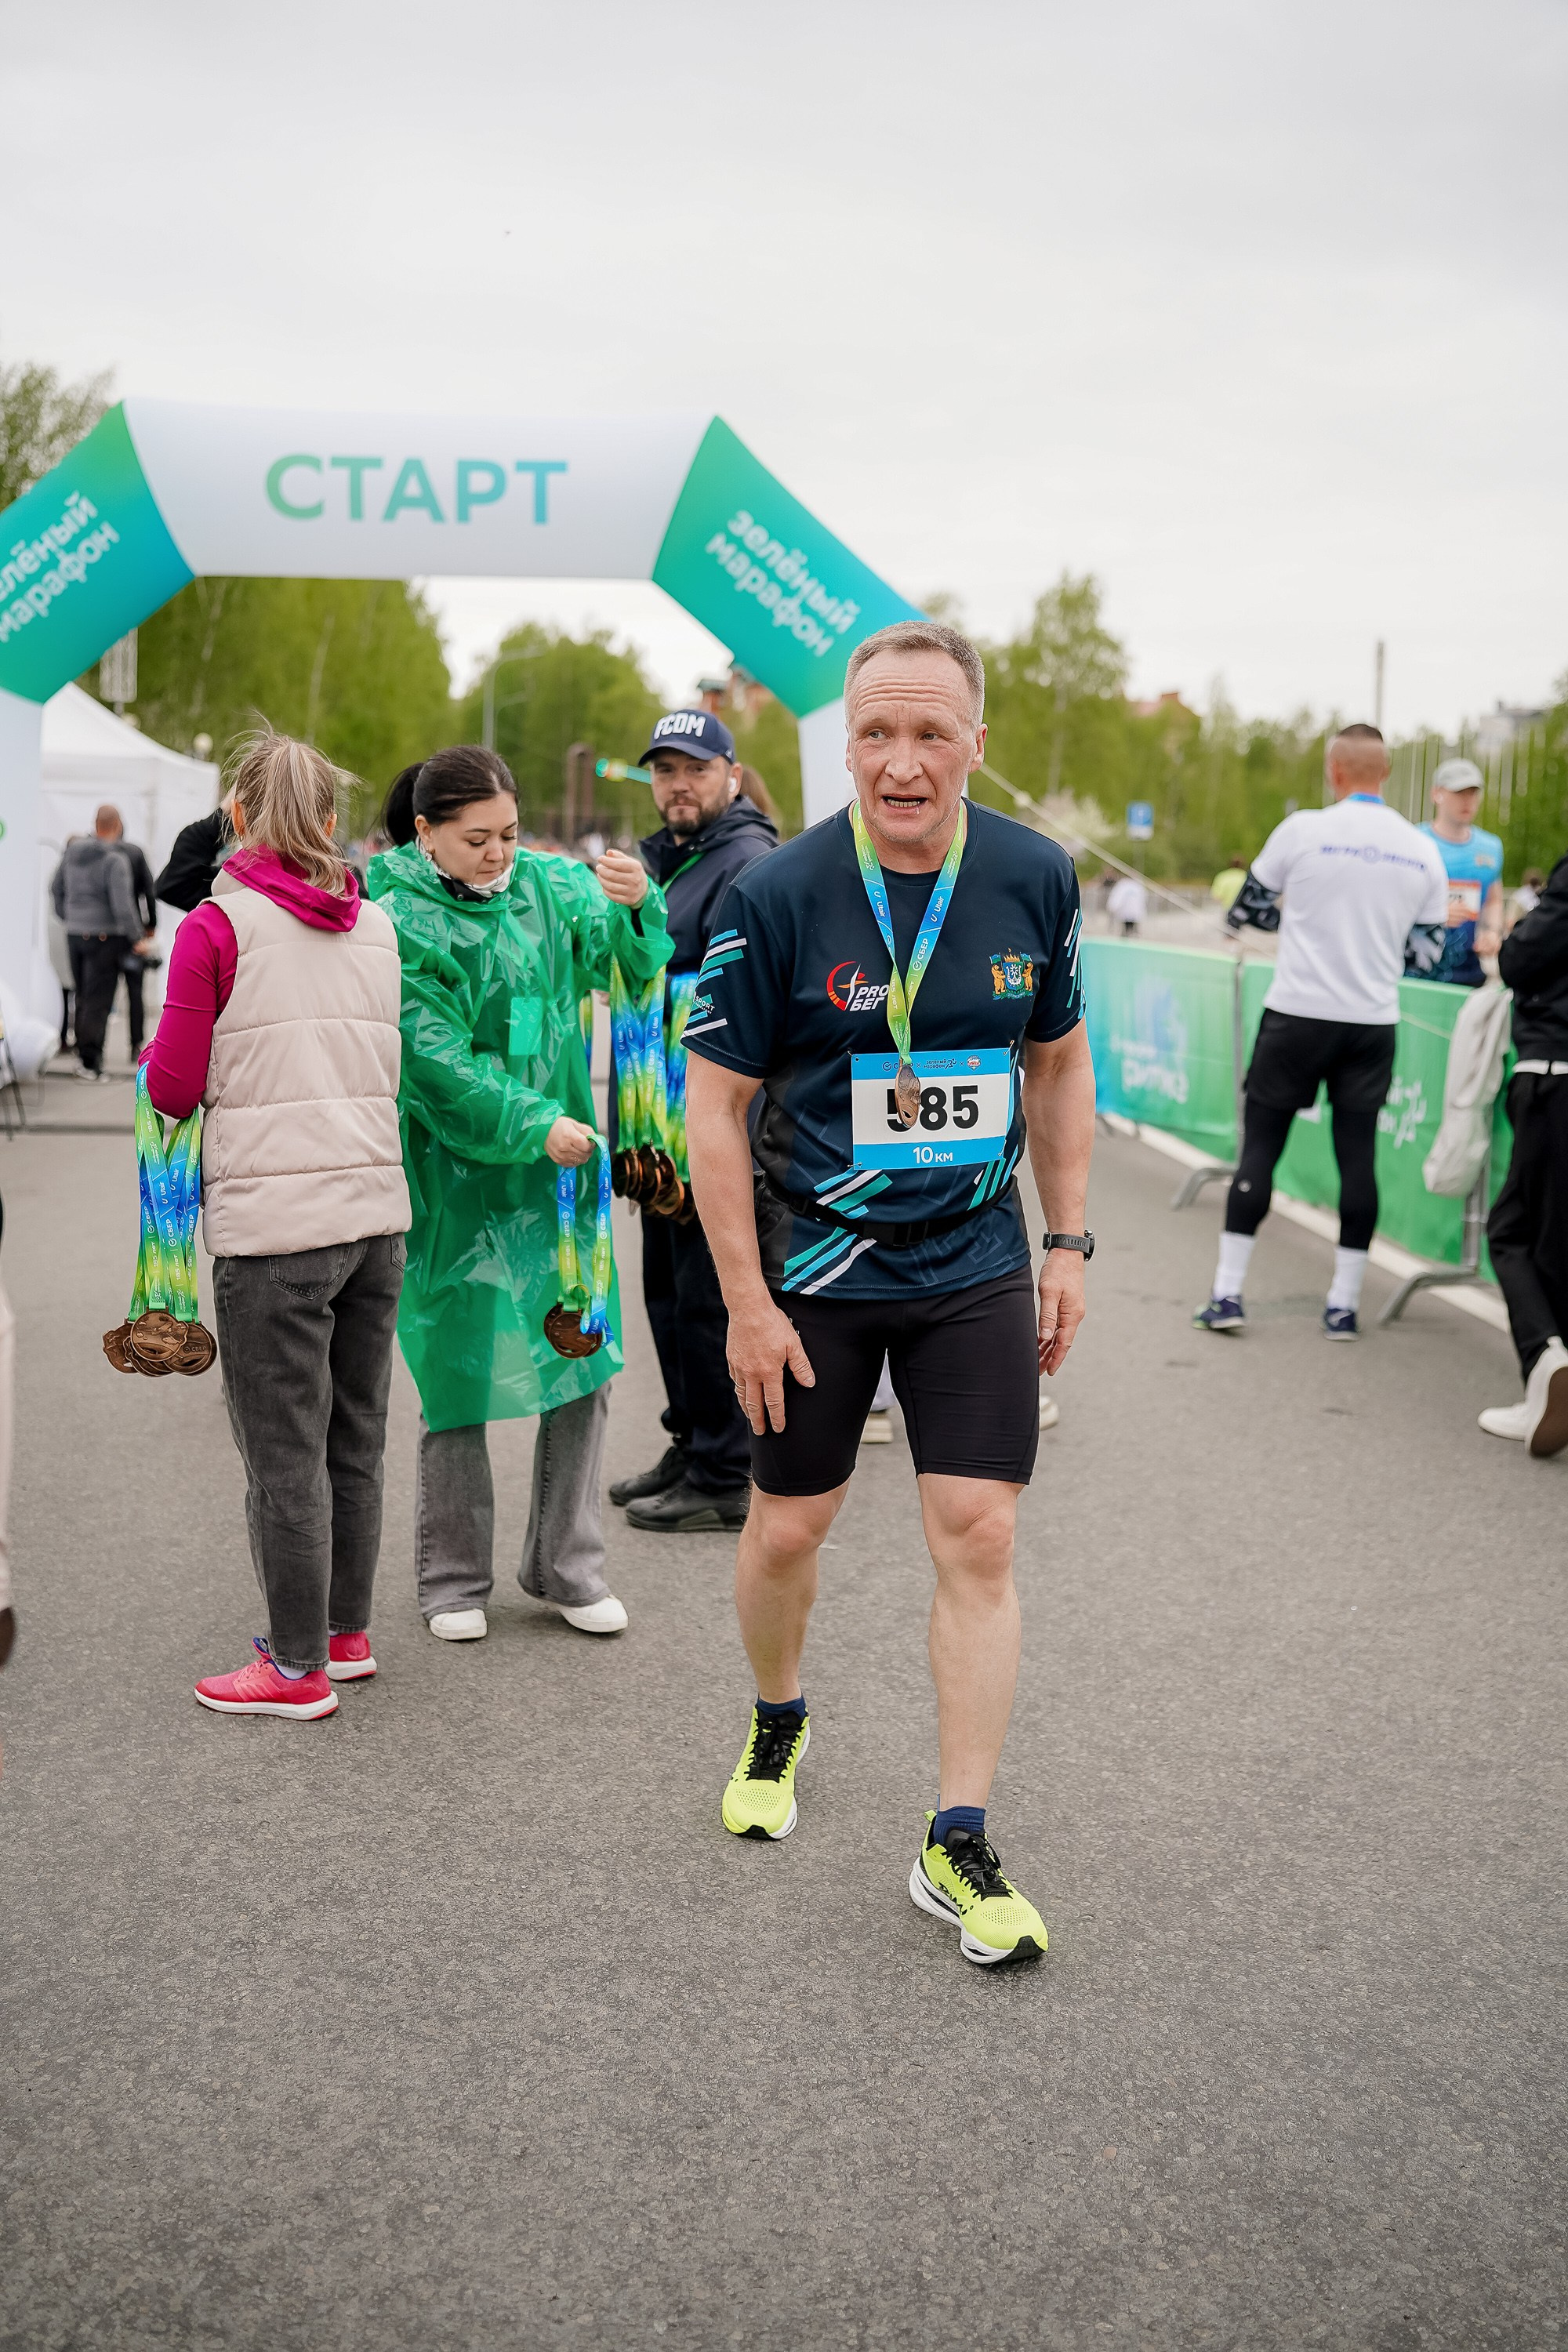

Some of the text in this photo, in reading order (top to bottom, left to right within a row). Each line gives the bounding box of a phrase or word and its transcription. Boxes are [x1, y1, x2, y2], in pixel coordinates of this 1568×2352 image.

[265, 453, 568, 525] СТАРТ
[726, 509, 862, 635] зелёный
[704, 531, 835, 658] марафон
[653, 712, 706, 740] FCDM
[877, 901, 886, 917] Utair
[934, 896, 945, 913] Utair
[916, 938, 929, 960] СБЕР
[855, 984, 890, 999] PRO
[695, 996, 715, 1011] SPORT
[849, 996, 885, 1011] БЕГ
[887, 1085, 979, 1133] 585
[913, 1146, 934, 1164] 10
[143, 1206, 152, 1225] СБЕР
[165, 1218, 174, 1237] СБЕР
